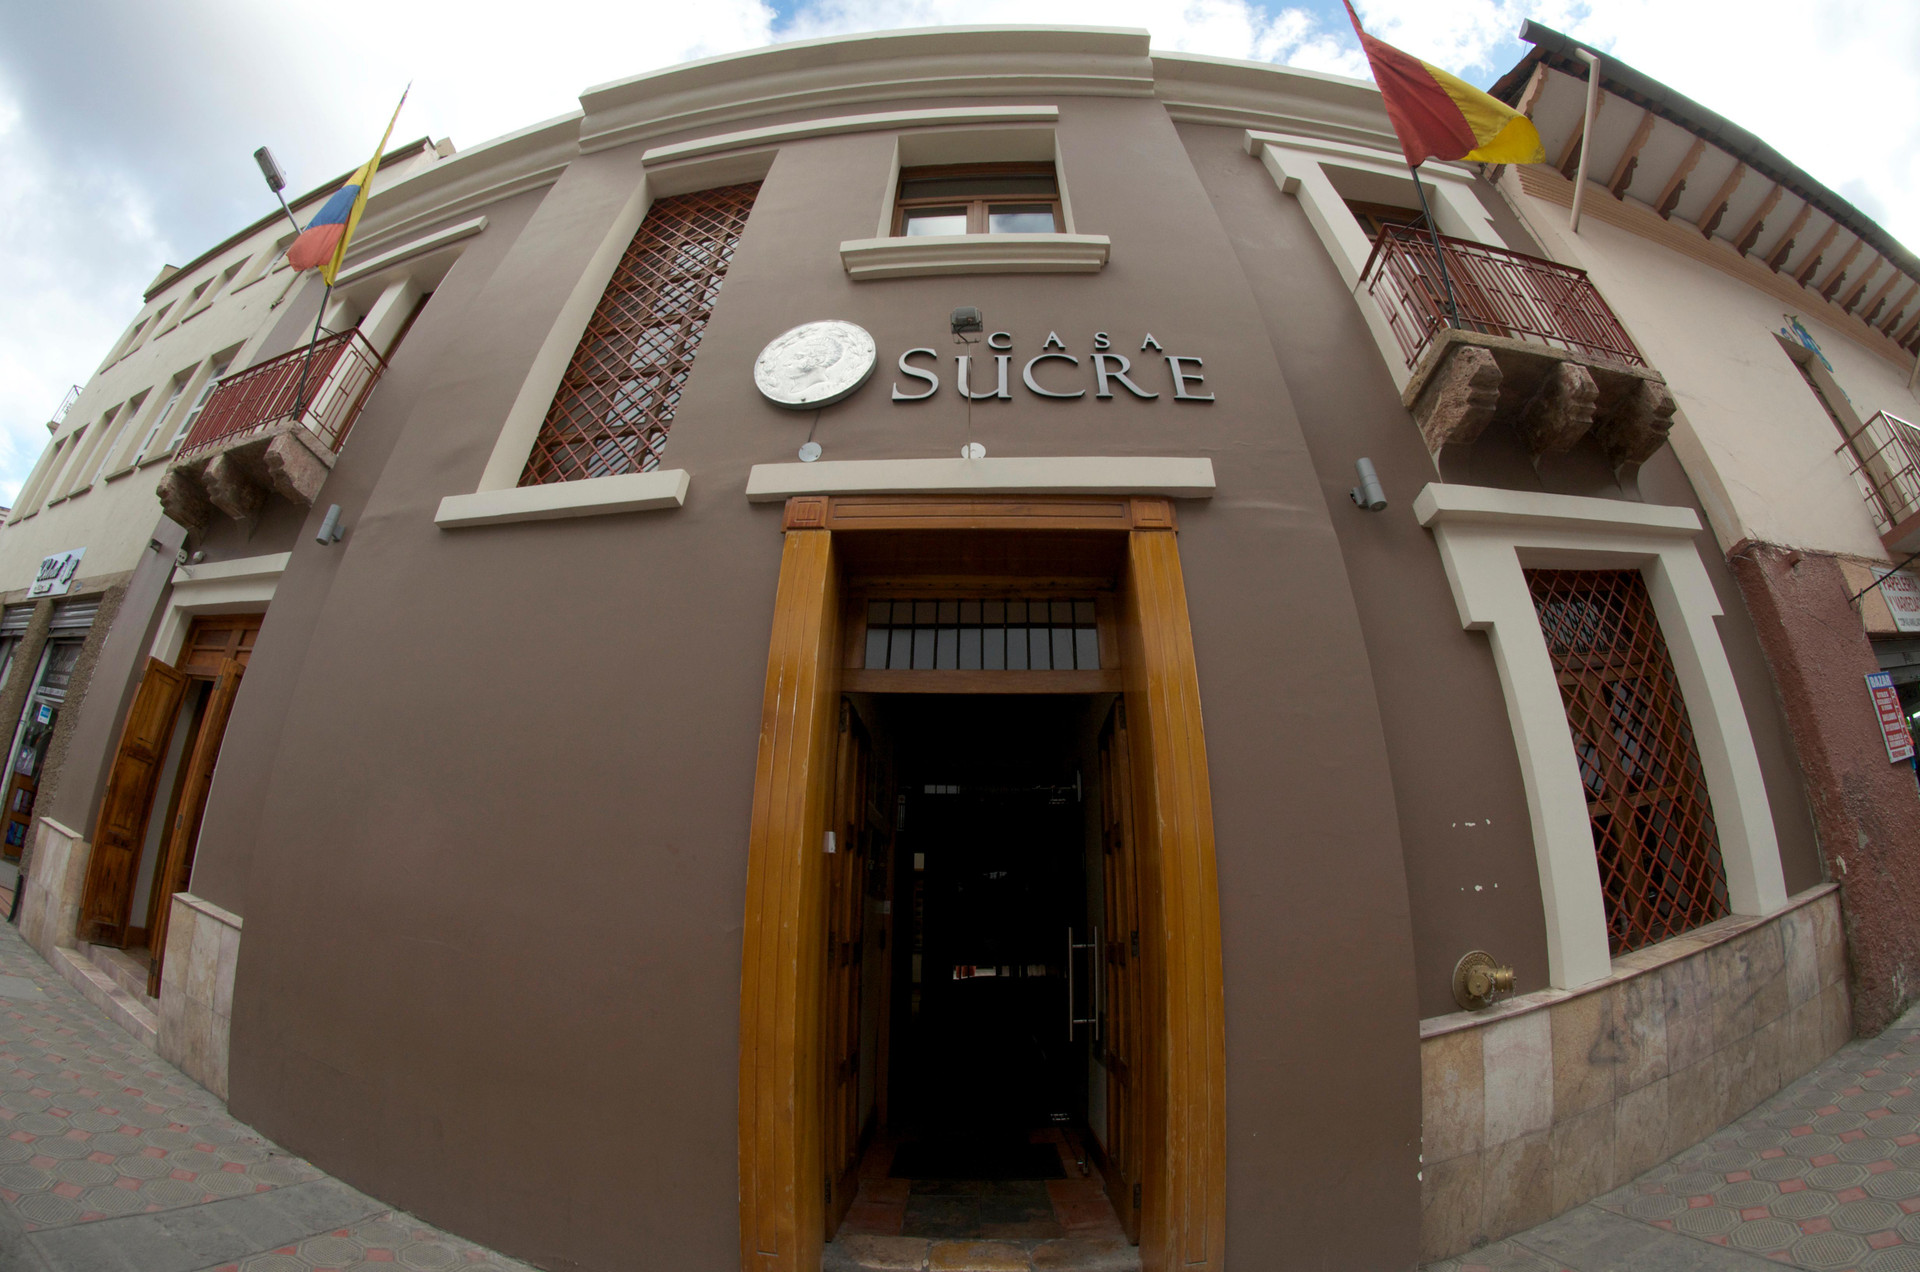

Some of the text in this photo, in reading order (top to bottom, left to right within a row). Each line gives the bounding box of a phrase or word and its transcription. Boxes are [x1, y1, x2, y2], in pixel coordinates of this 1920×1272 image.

[987, 331, 1163, 351] CASA
[891, 348, 1216, 401] SUCRE
[1868, 674, 1892, 688] BAZAR
